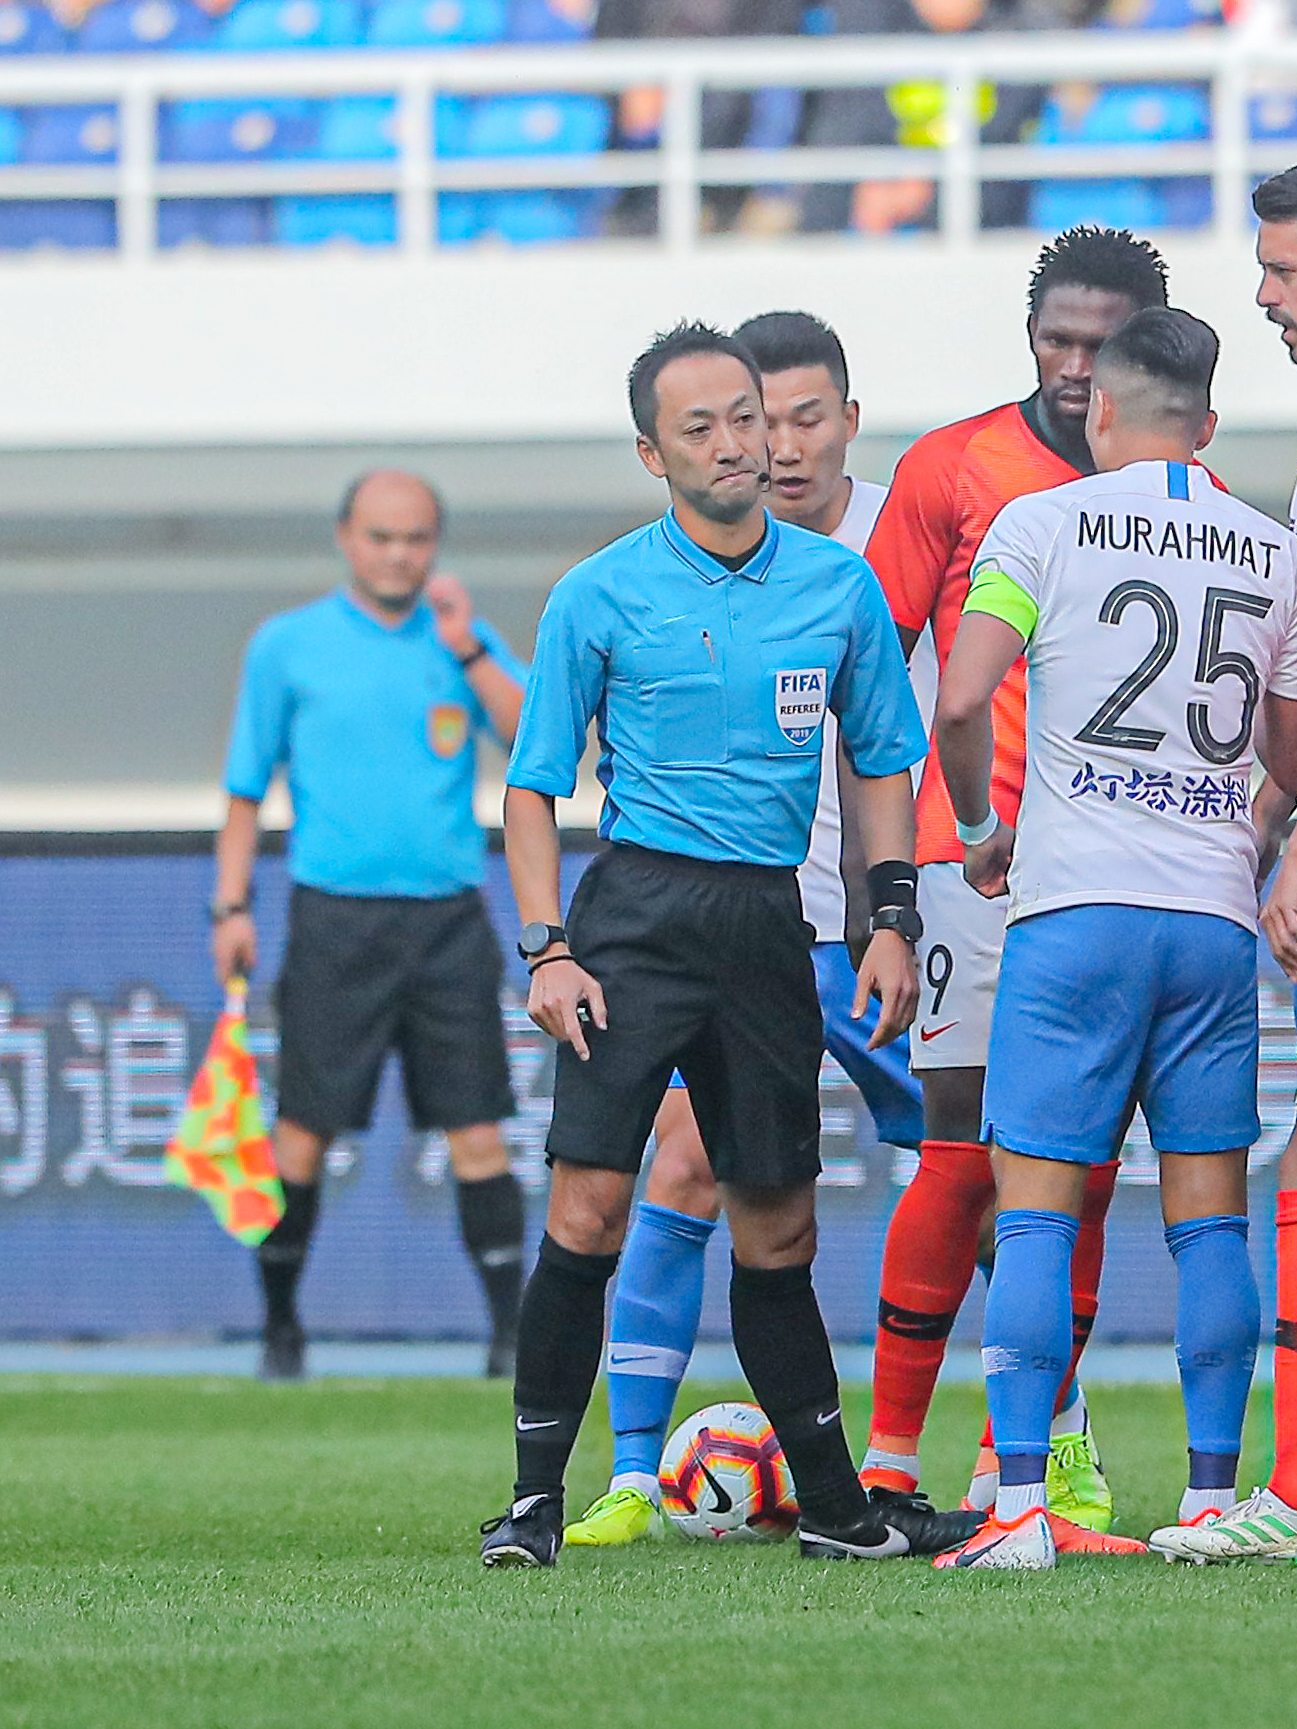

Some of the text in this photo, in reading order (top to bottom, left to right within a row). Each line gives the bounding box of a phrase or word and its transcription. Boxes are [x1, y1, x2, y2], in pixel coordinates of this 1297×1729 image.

[1077, 511, 1281, 579] MURAHMAT
[781, 674, 821, 692] FIFA
[1073, 579, 1274, 765] 25
[780, 704, 820, 715] REFEREE
[790, 729, 809, 738] 2019
[1068, 761, 1252, 822] 灯塔涂料
[926, 943, 954, 1016] 9
